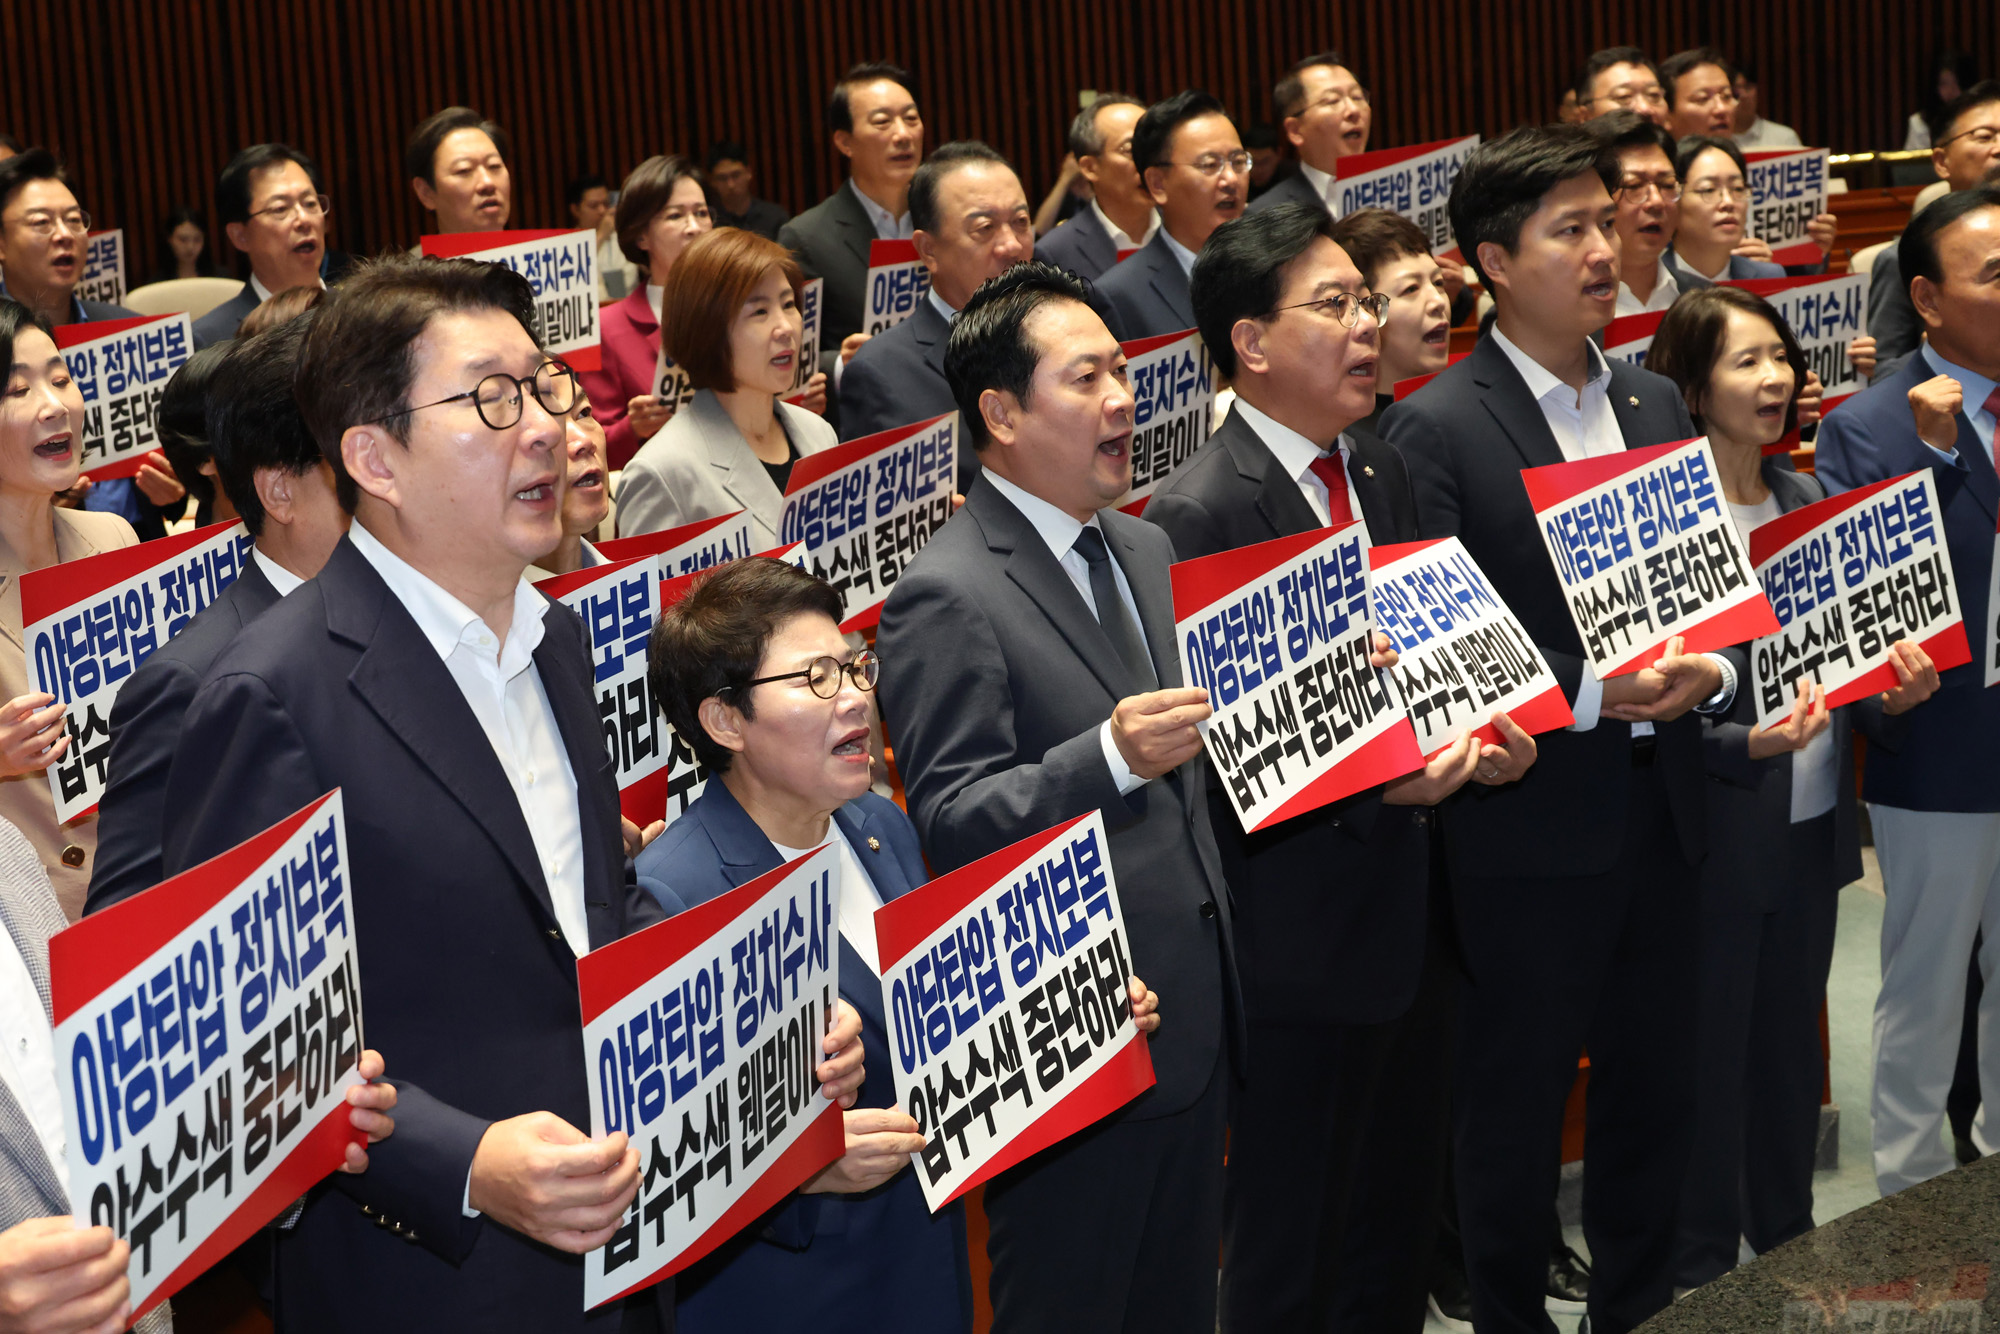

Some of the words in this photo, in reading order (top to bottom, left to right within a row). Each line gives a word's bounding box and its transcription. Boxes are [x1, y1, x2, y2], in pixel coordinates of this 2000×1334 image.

[1417, 146, 1476, 207] 정치수
[523, 240, 591, 297] 정치수사
[1795, 284, 1862, 339] 치수사
[102, 321, 187, 396] 정치보복
[109, 383, 167, 453] 중단
[1134, 343, 1215, 426] 정치수사
[781, 464, 872, 552] 야당탄압
[875, 422, 953, 519] 정치보복
[1545, 488, 1634, 586] 야당탄압
[1625, 449, 1722, 551] 정치보복
[1834, 480, 1937, 588] 정치보복
[34, 581, 158, 708] 야당탄압
[569, 571, 653, 684] 보복
[1186, 585, 1285, 713] 야당탄압
[1276, 535, 1370, 664] 정치보복
[1372, 579, 1435, 655] 탄압
[1401, 552, 1499, 633] 정치수사
[1572, 564, 1654, 664] 압수수색
[1645, 522, 1750, 627] 중단하라
[1758, 603, 1855, 716] 압수수색
[1848, 552, 1952, 660] 중단하라
[597, 672, 661, 775] 하라
[1208, 680, 1311, 814] 압수수색
[1294, 628, 1394, 758] 중단하라
[1389, 646, 1477, 740] 수수색
[1450, 616, 1545, 706] 웬말이냐
[50, 702, 111, 805] 압수
[71, 925, 228, 1166] 야당탄압
[230, 813, 349, 1036] 정치보복
[598, 955, 724, 1139] 야당탄압
[731, 868, 832, 1045] 정치수사
[889, 908, 1006, 1076] 야당탄압
[995, 826, 1114, 989] 정치보복
[241, 949, 365, 1176] 중단하라
[907, 1015, 1035, 1188] 압수수색
[1018, 928, 1136, 1079] 중단하라
